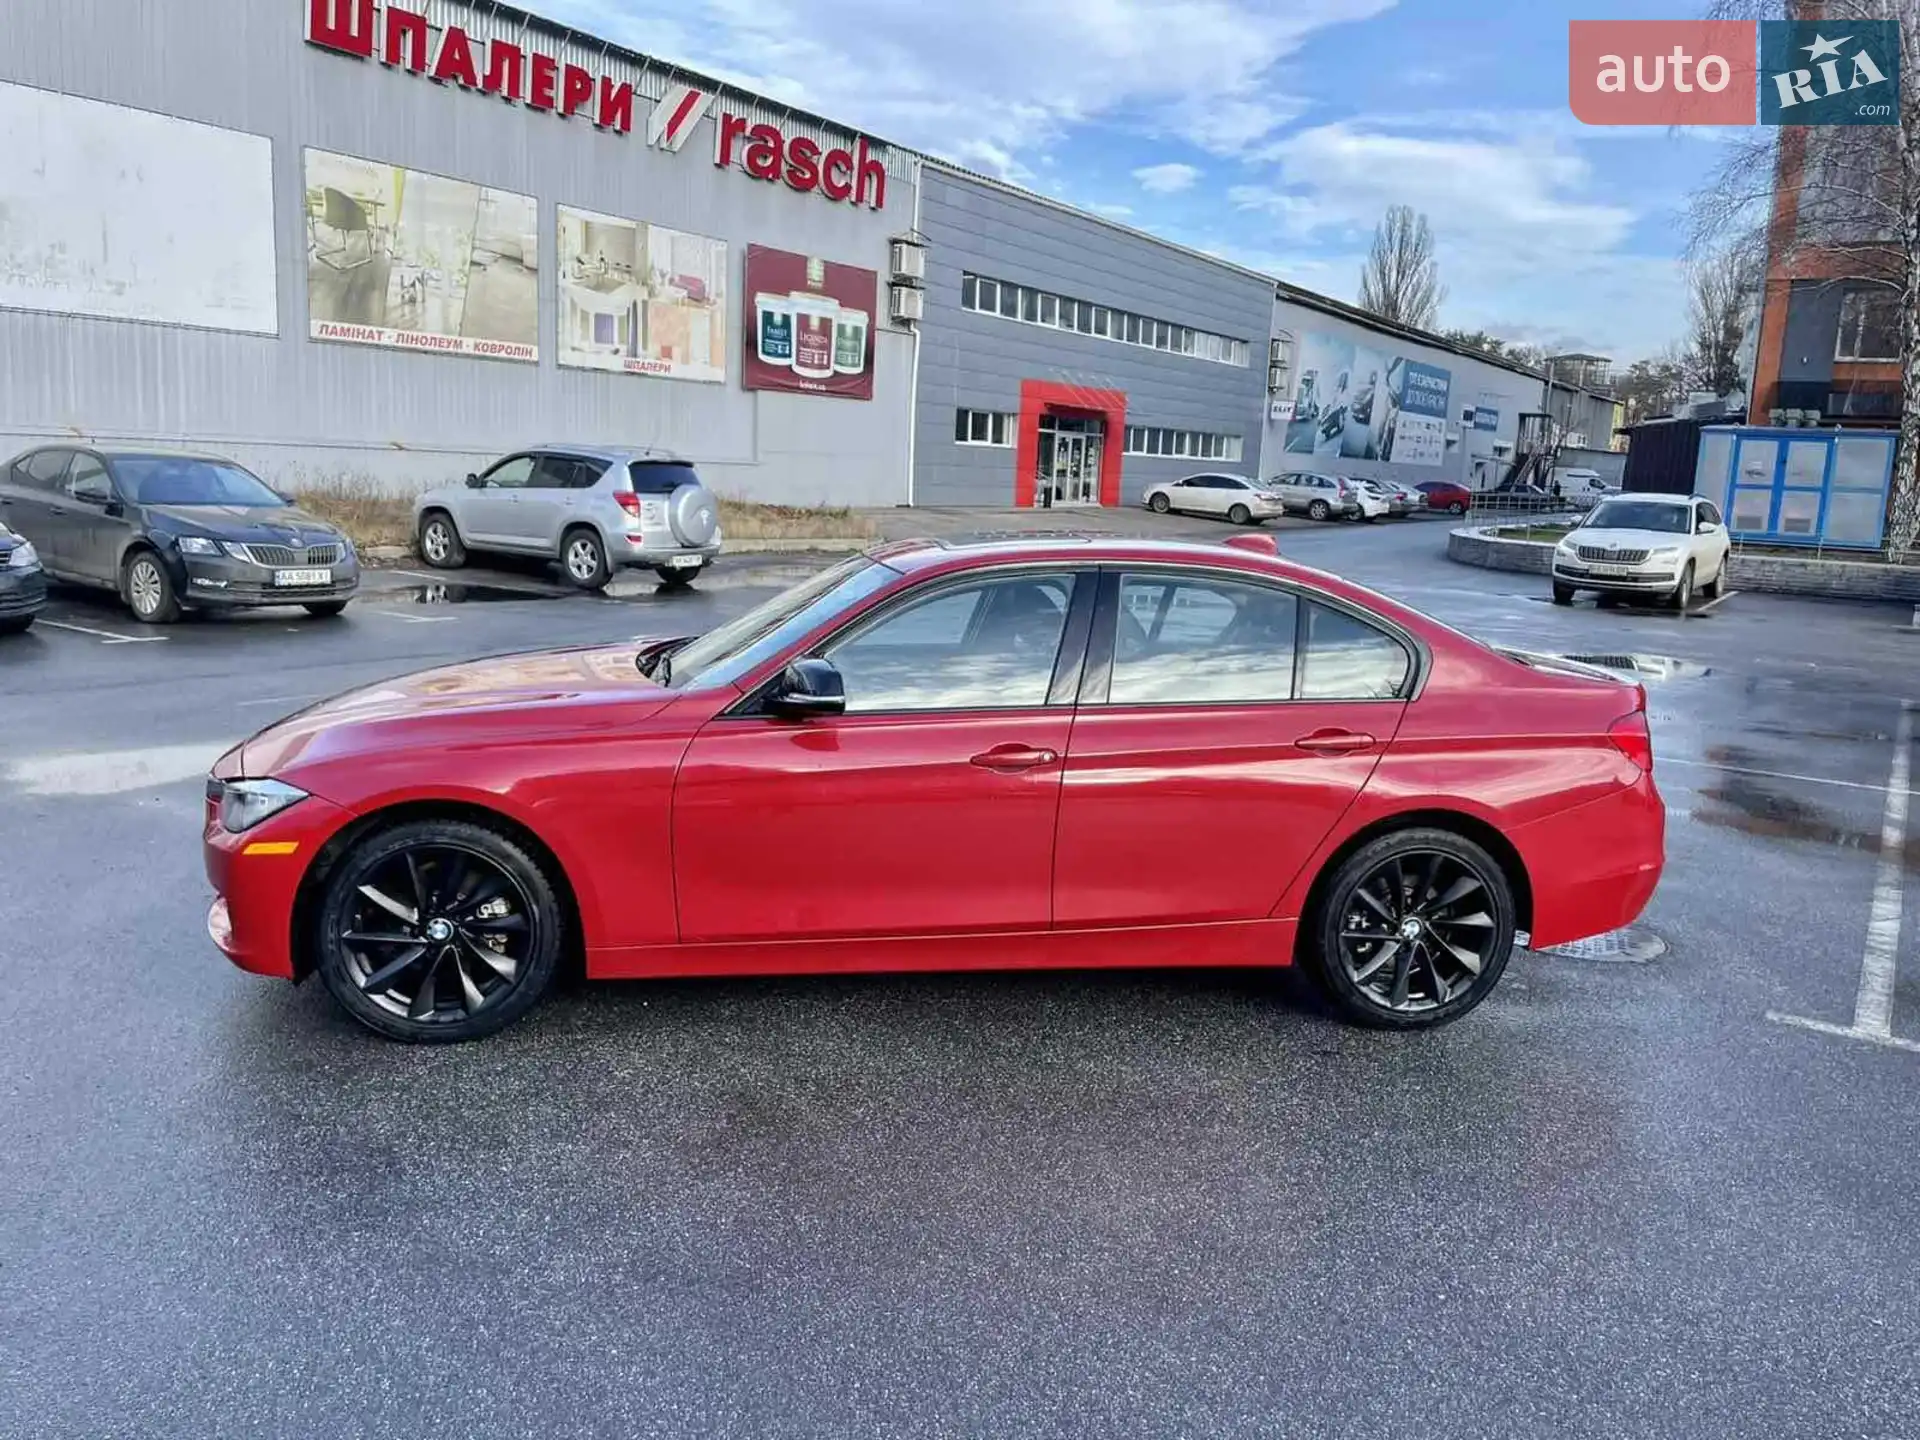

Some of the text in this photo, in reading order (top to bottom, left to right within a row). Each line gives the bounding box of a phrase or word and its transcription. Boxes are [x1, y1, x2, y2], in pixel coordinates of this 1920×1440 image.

[307, 0, 633, 134] ШПАЛЕРИ
[715, 111, 885, 210] rasch
[318, 323, 533, 358] ЛАМІНАТ ЛІНОЛЕУМ КОВРОЛІН
[623, 359, 671, 374] ШПАЛЕРИ
